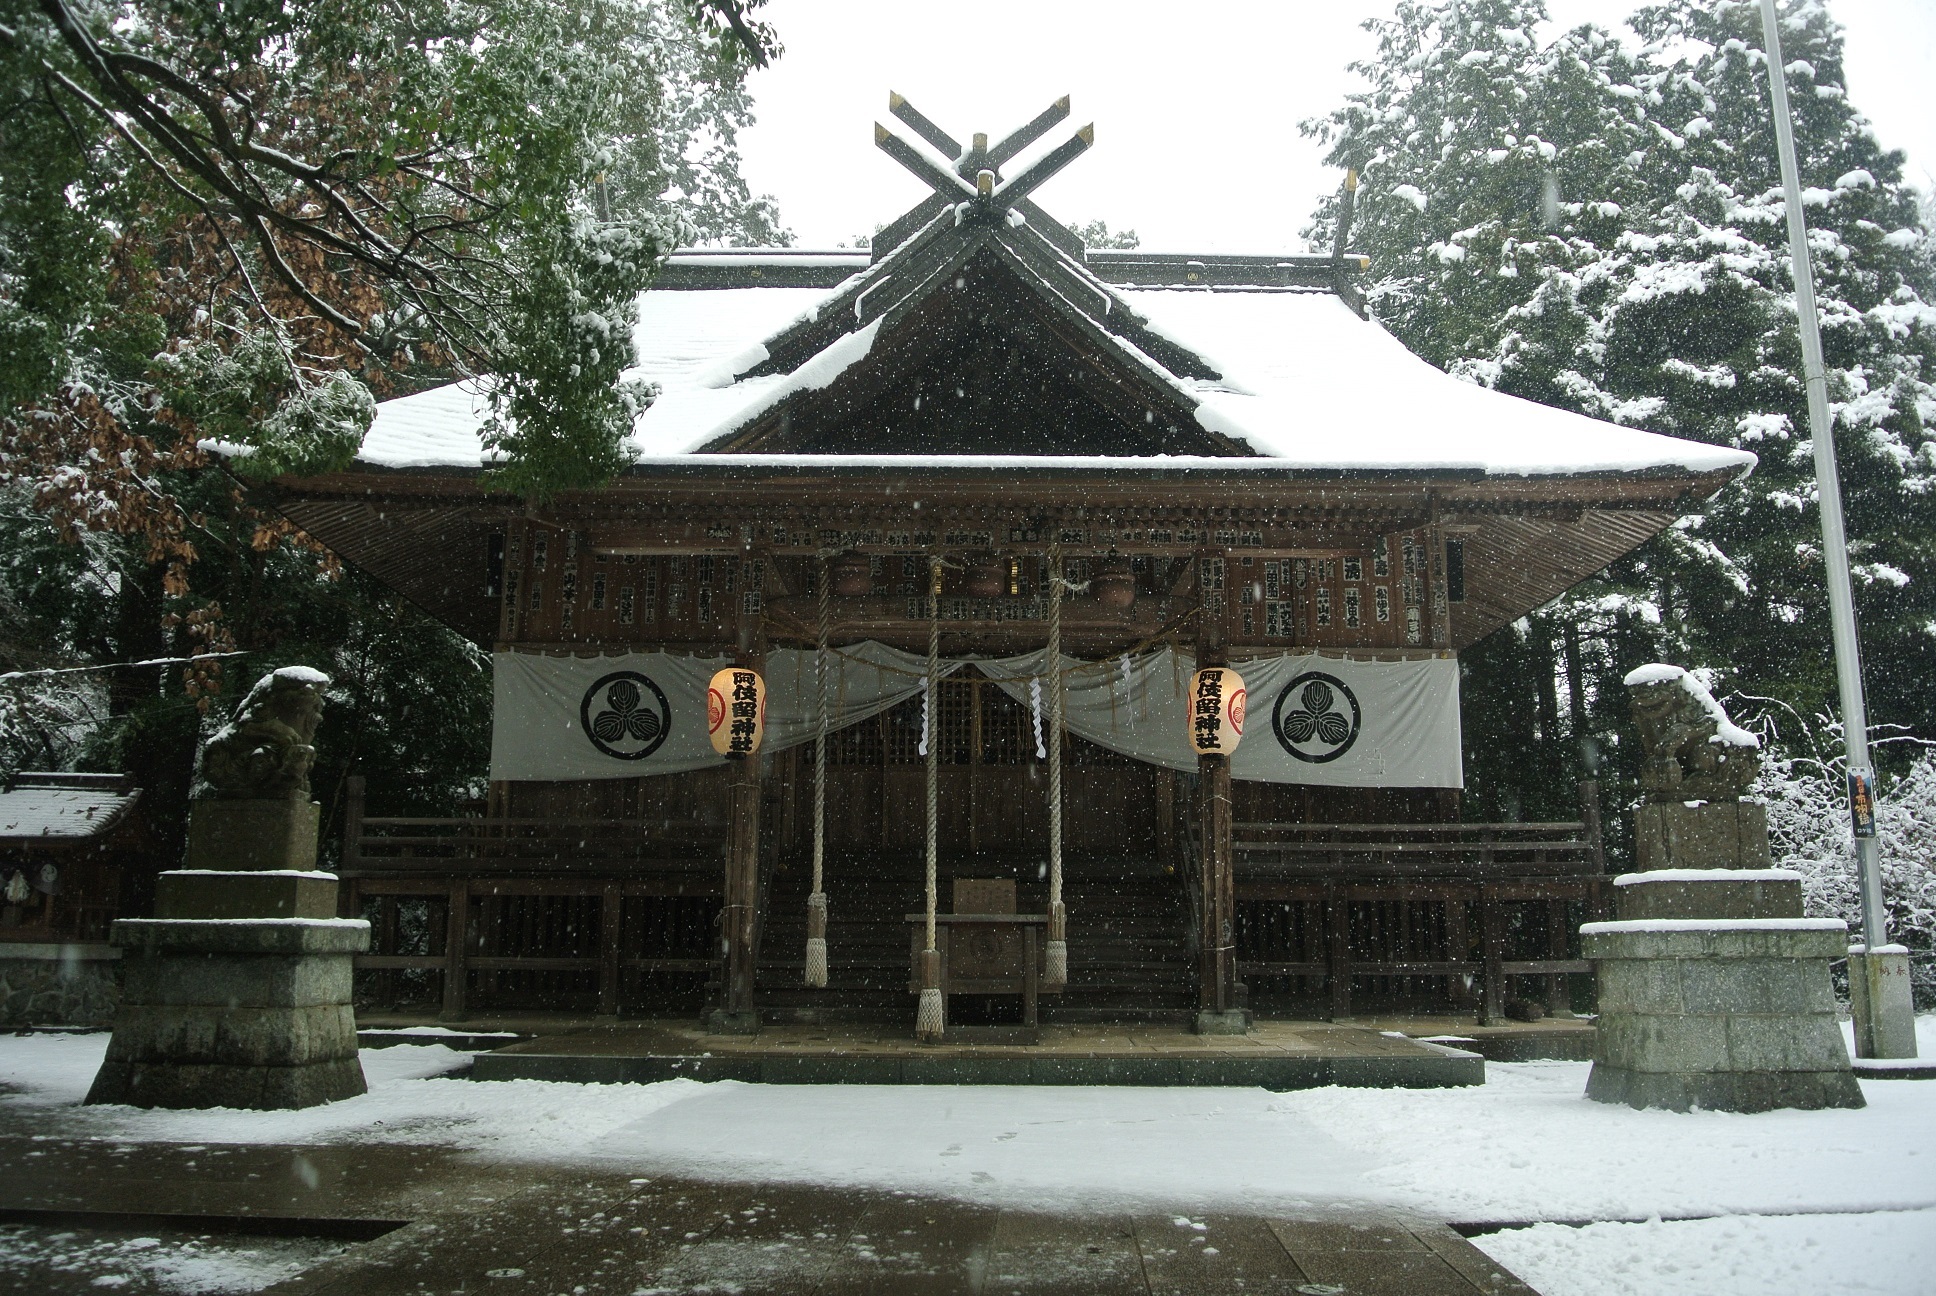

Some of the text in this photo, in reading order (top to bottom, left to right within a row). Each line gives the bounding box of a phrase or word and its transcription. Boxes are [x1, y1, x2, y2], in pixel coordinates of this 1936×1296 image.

[729, 672, 758, 752] 阿伎留神社
[1195, 670, 1224, 750] 阿伎留神社
